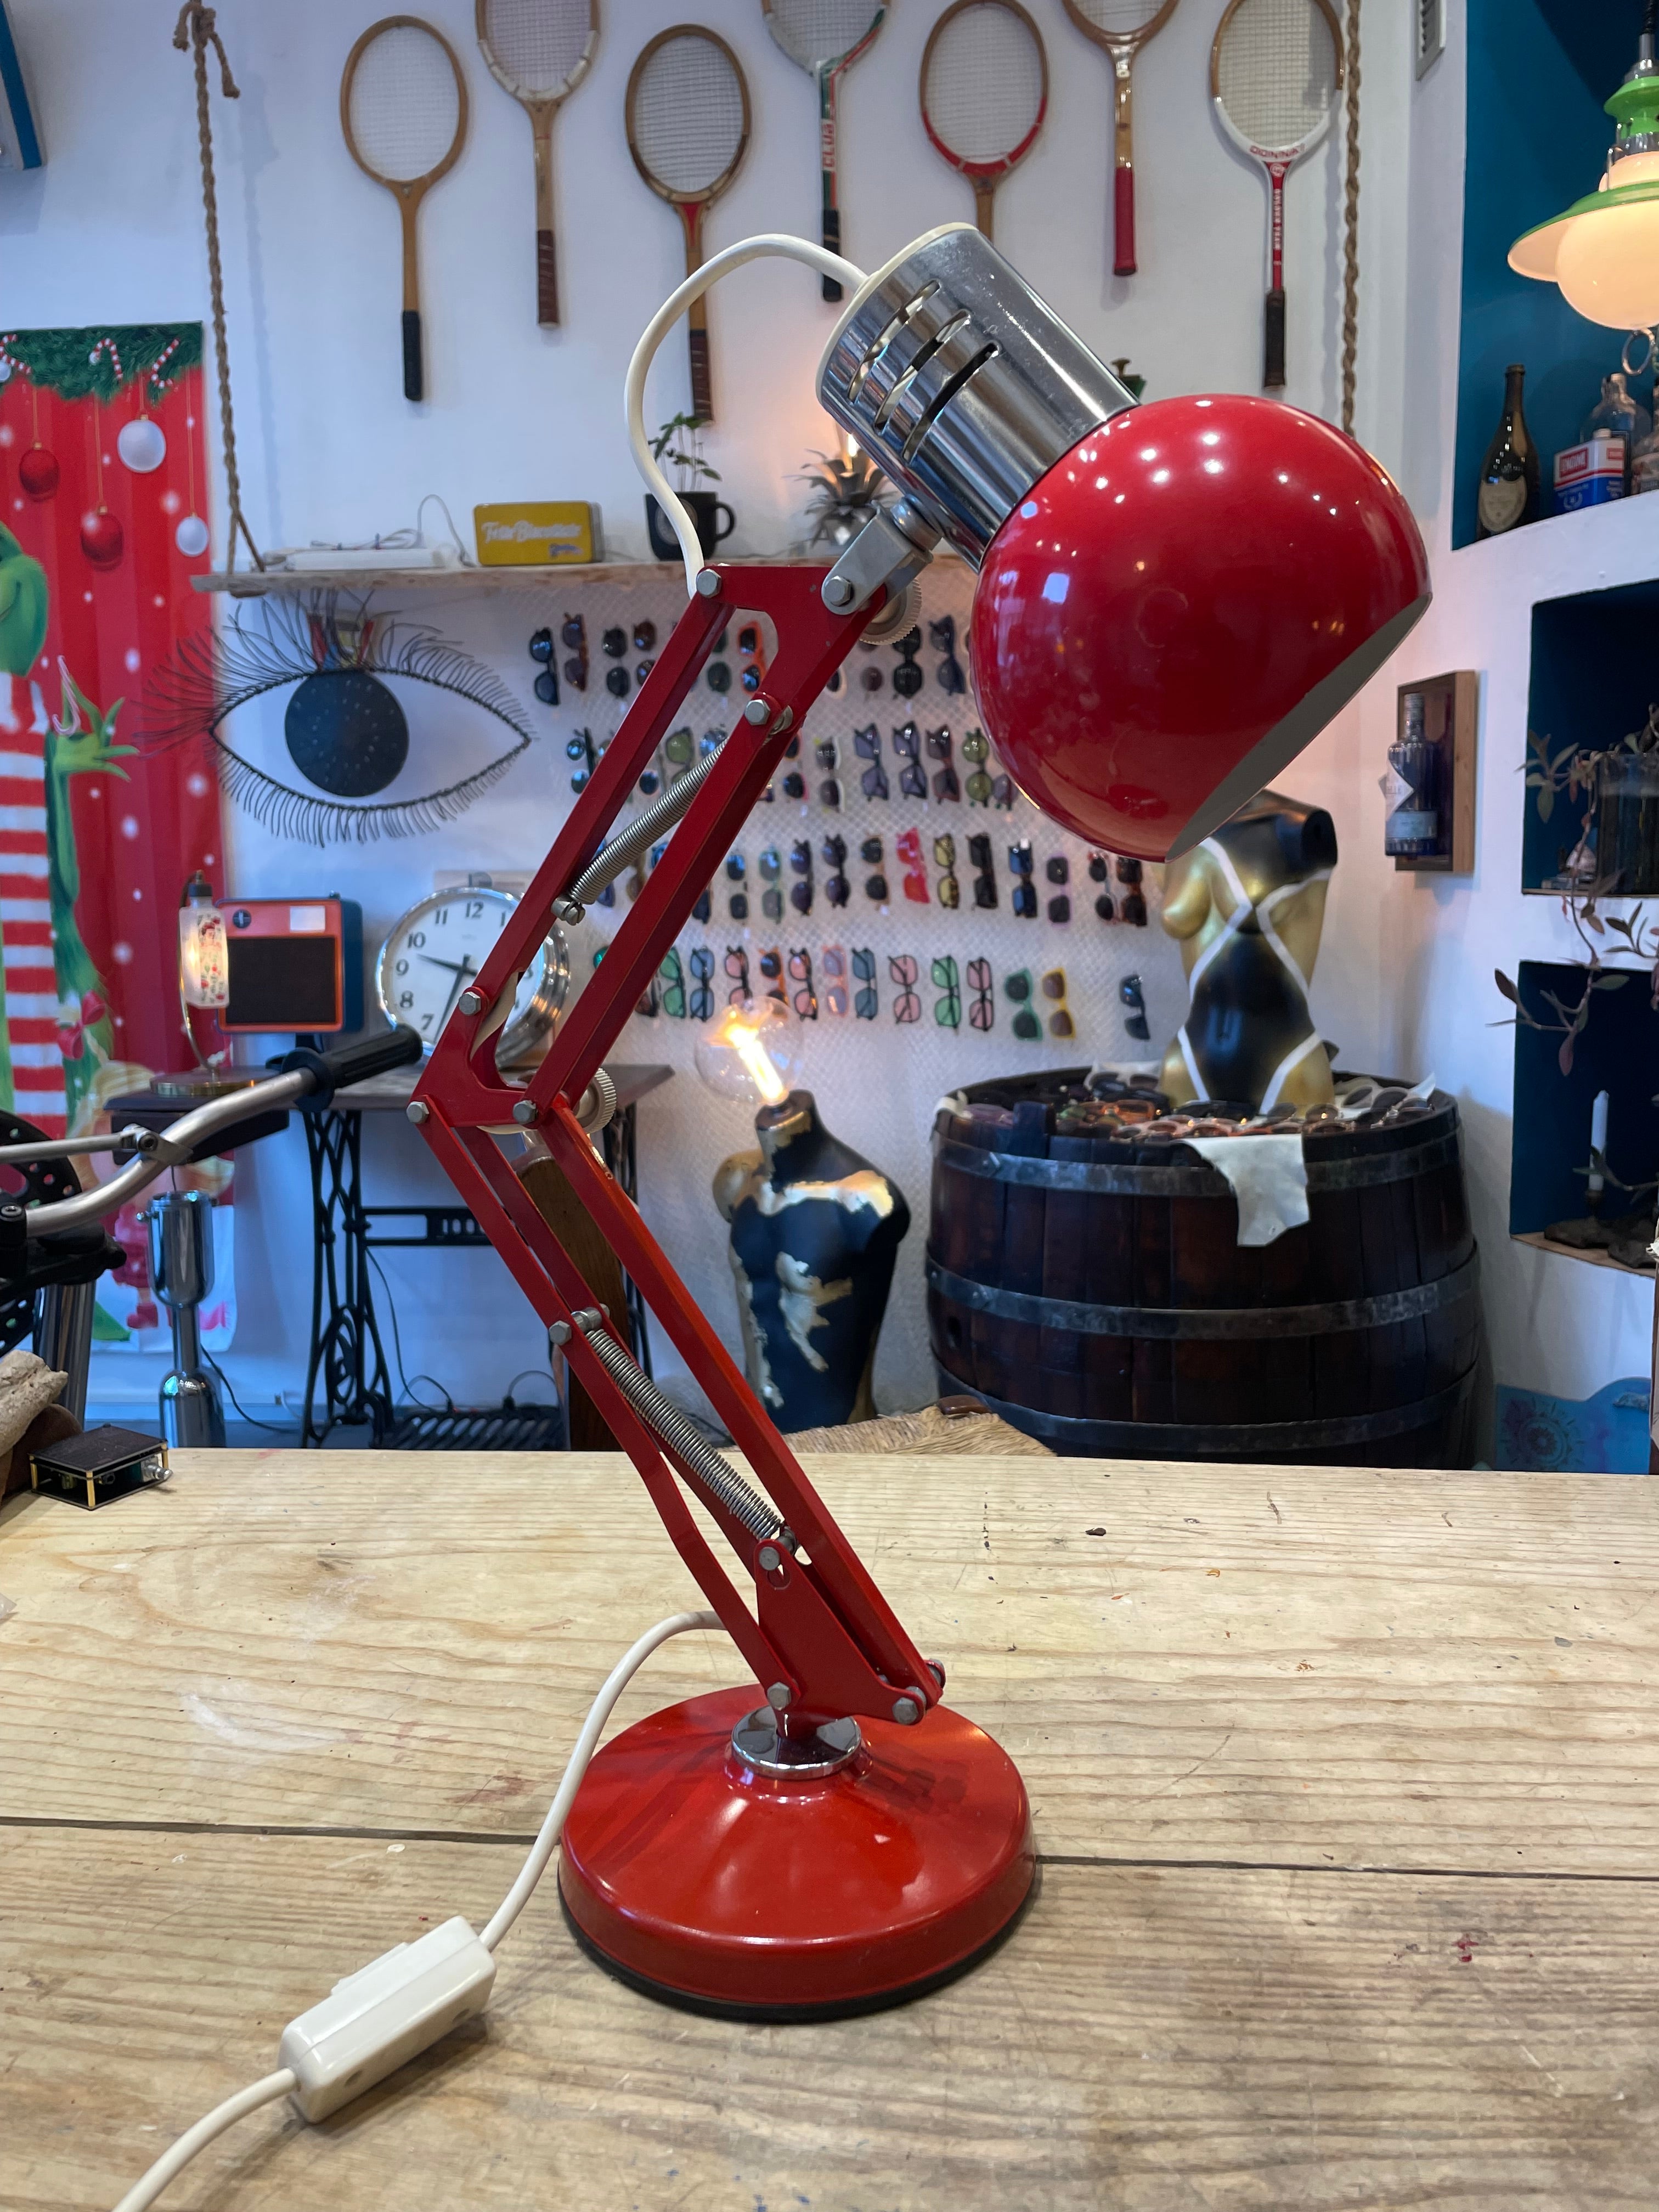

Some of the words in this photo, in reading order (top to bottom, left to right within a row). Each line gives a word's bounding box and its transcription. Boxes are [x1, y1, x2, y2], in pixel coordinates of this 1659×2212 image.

[435, 909, 449, 926] 11
[465, 901, 483, 919] 12
[500, 911, 507, 927] 1
[408, 932, 426, 949] 10
[396, 960, 409, 976] 9
[399, 991, 414, 1008] 8
[421, 1013, 435, 1031] 7
